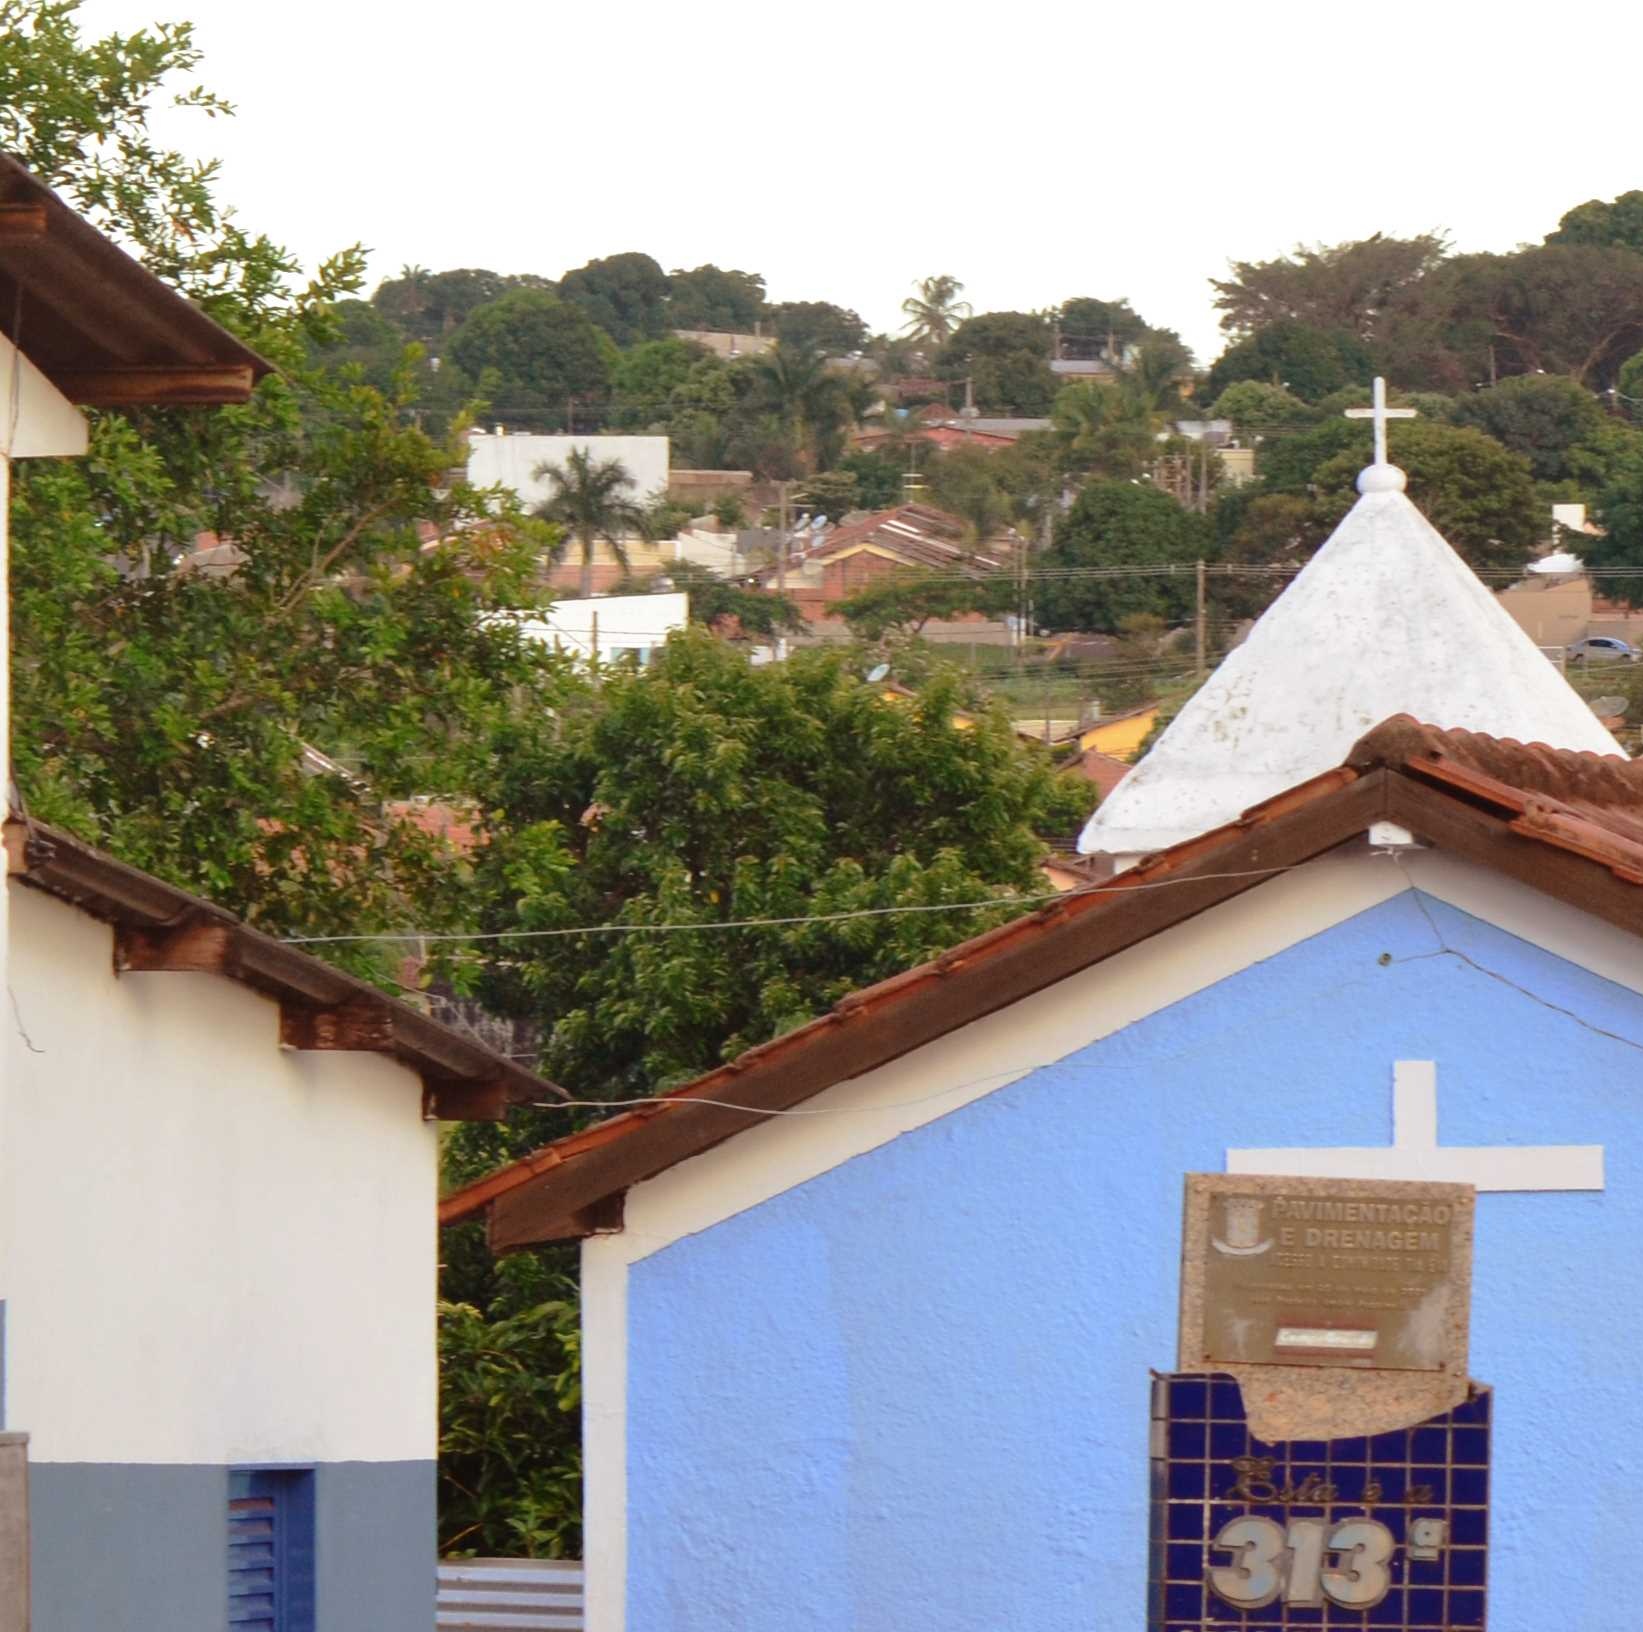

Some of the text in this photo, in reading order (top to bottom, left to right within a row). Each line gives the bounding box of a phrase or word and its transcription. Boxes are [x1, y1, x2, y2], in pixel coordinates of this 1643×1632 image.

[1271, 1199, 1451, 1228] PAVIMENTAÇÃO
[1280, 1227, 1440, 1252] E DRENAGEM
